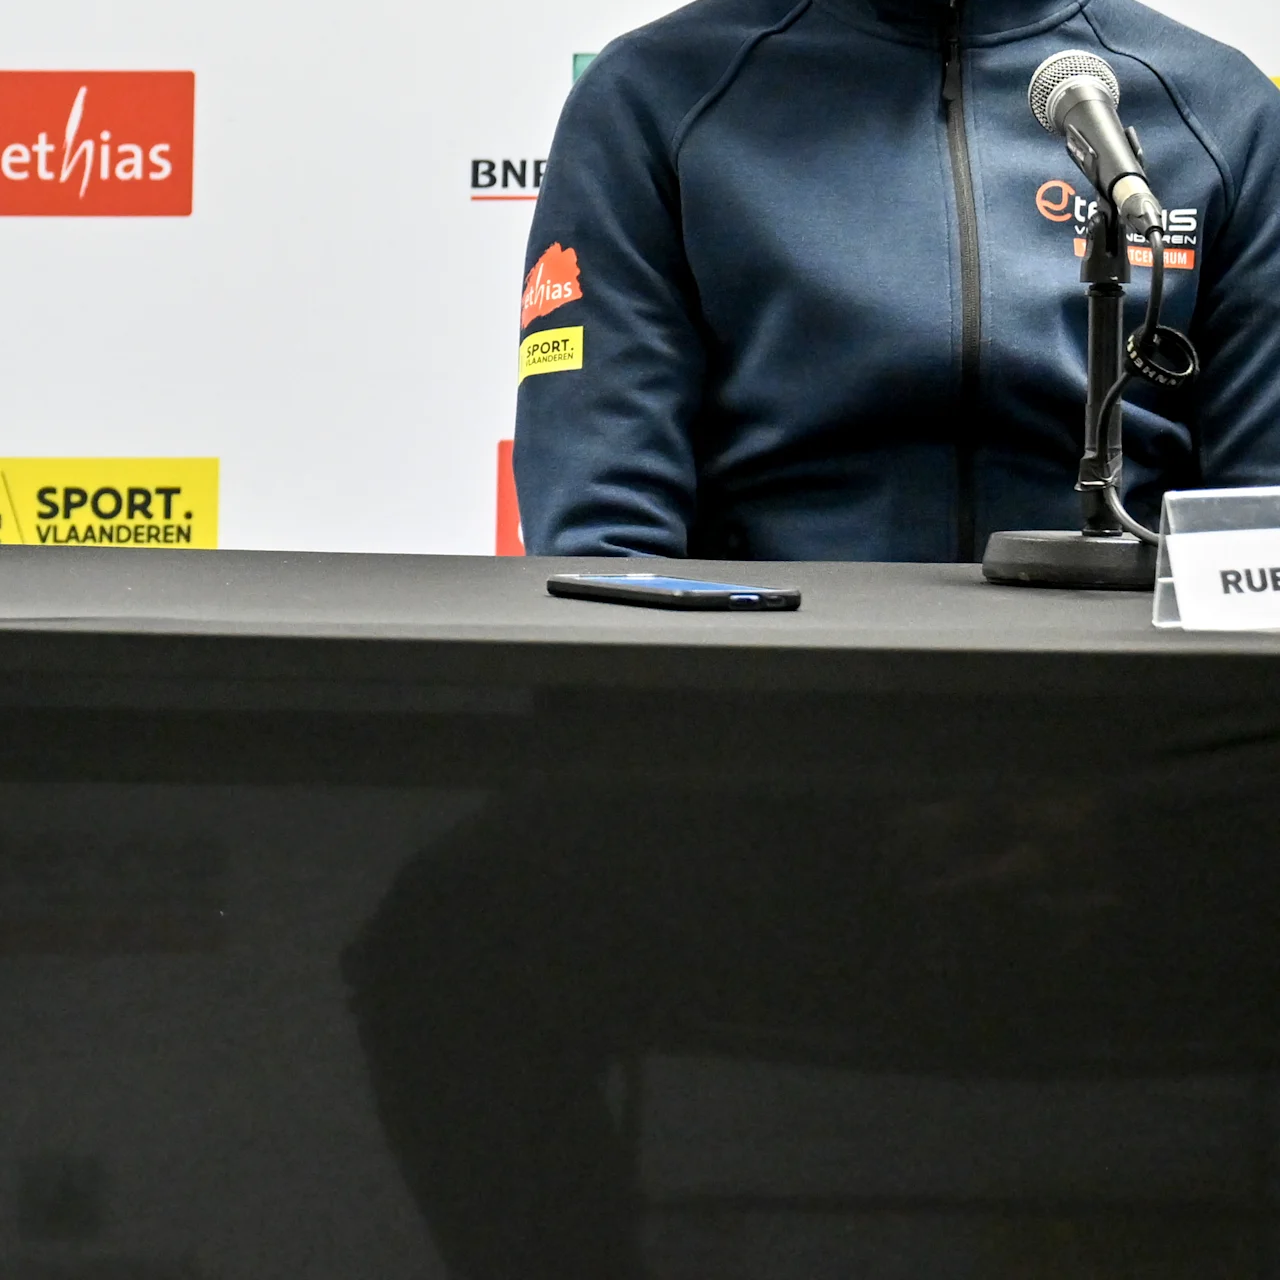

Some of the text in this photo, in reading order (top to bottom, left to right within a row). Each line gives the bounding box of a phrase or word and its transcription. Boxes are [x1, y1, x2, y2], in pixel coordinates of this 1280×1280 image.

[1, 85, 173, 198] ethias
[524, 263, 572, 309] ethias
[526, 339, 574, 358] SPORT.
[36, 486, 193, 521] SPORT.
[35, 524, 192, 544] VLAANDEREN
